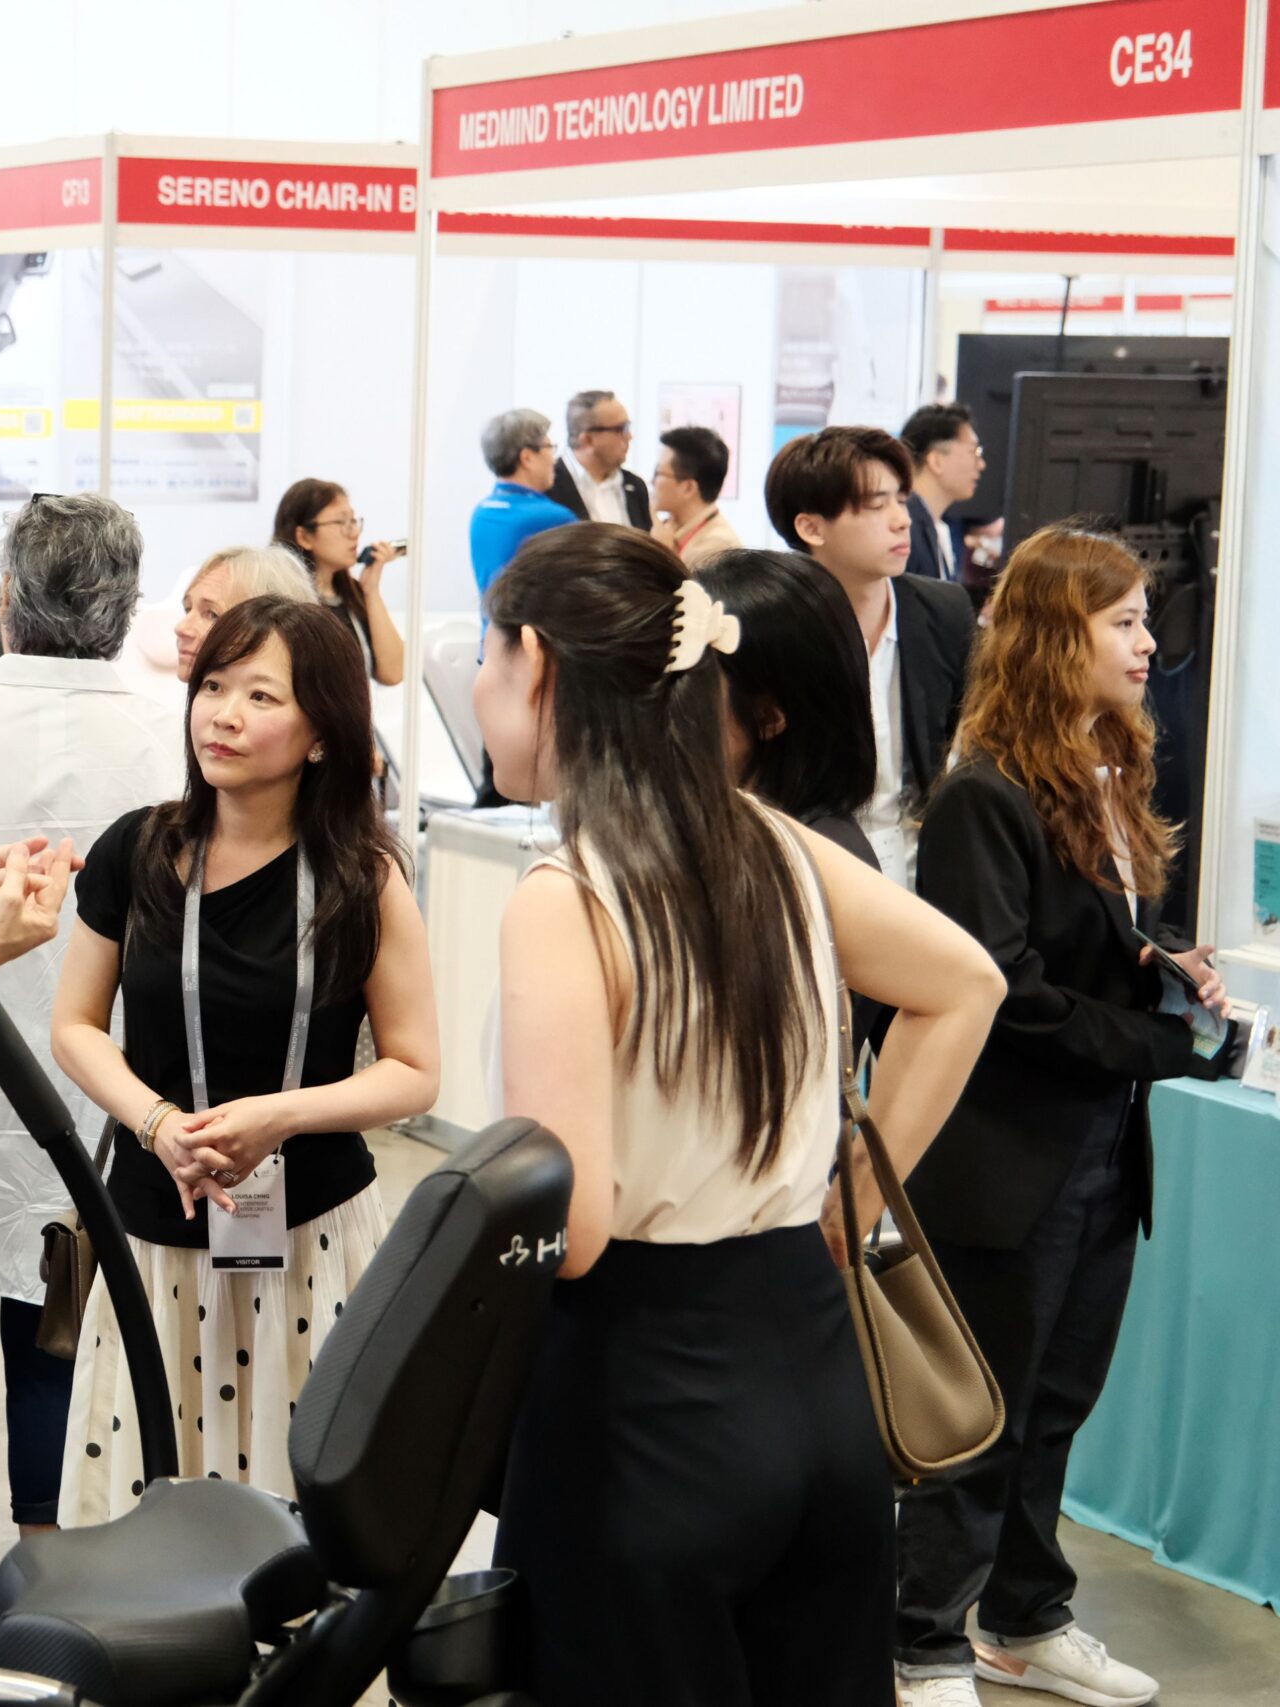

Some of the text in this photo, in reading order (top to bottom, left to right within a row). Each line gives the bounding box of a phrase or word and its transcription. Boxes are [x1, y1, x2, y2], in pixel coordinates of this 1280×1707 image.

[1109, 28, 1194, 88] CE34
[458, 73, 805, 150] MEDMIND TECHNOLOGY LIMITED
[157, 175, 270, 209] SERENO
[275, 179, 393, 212] CHAIR-IN
